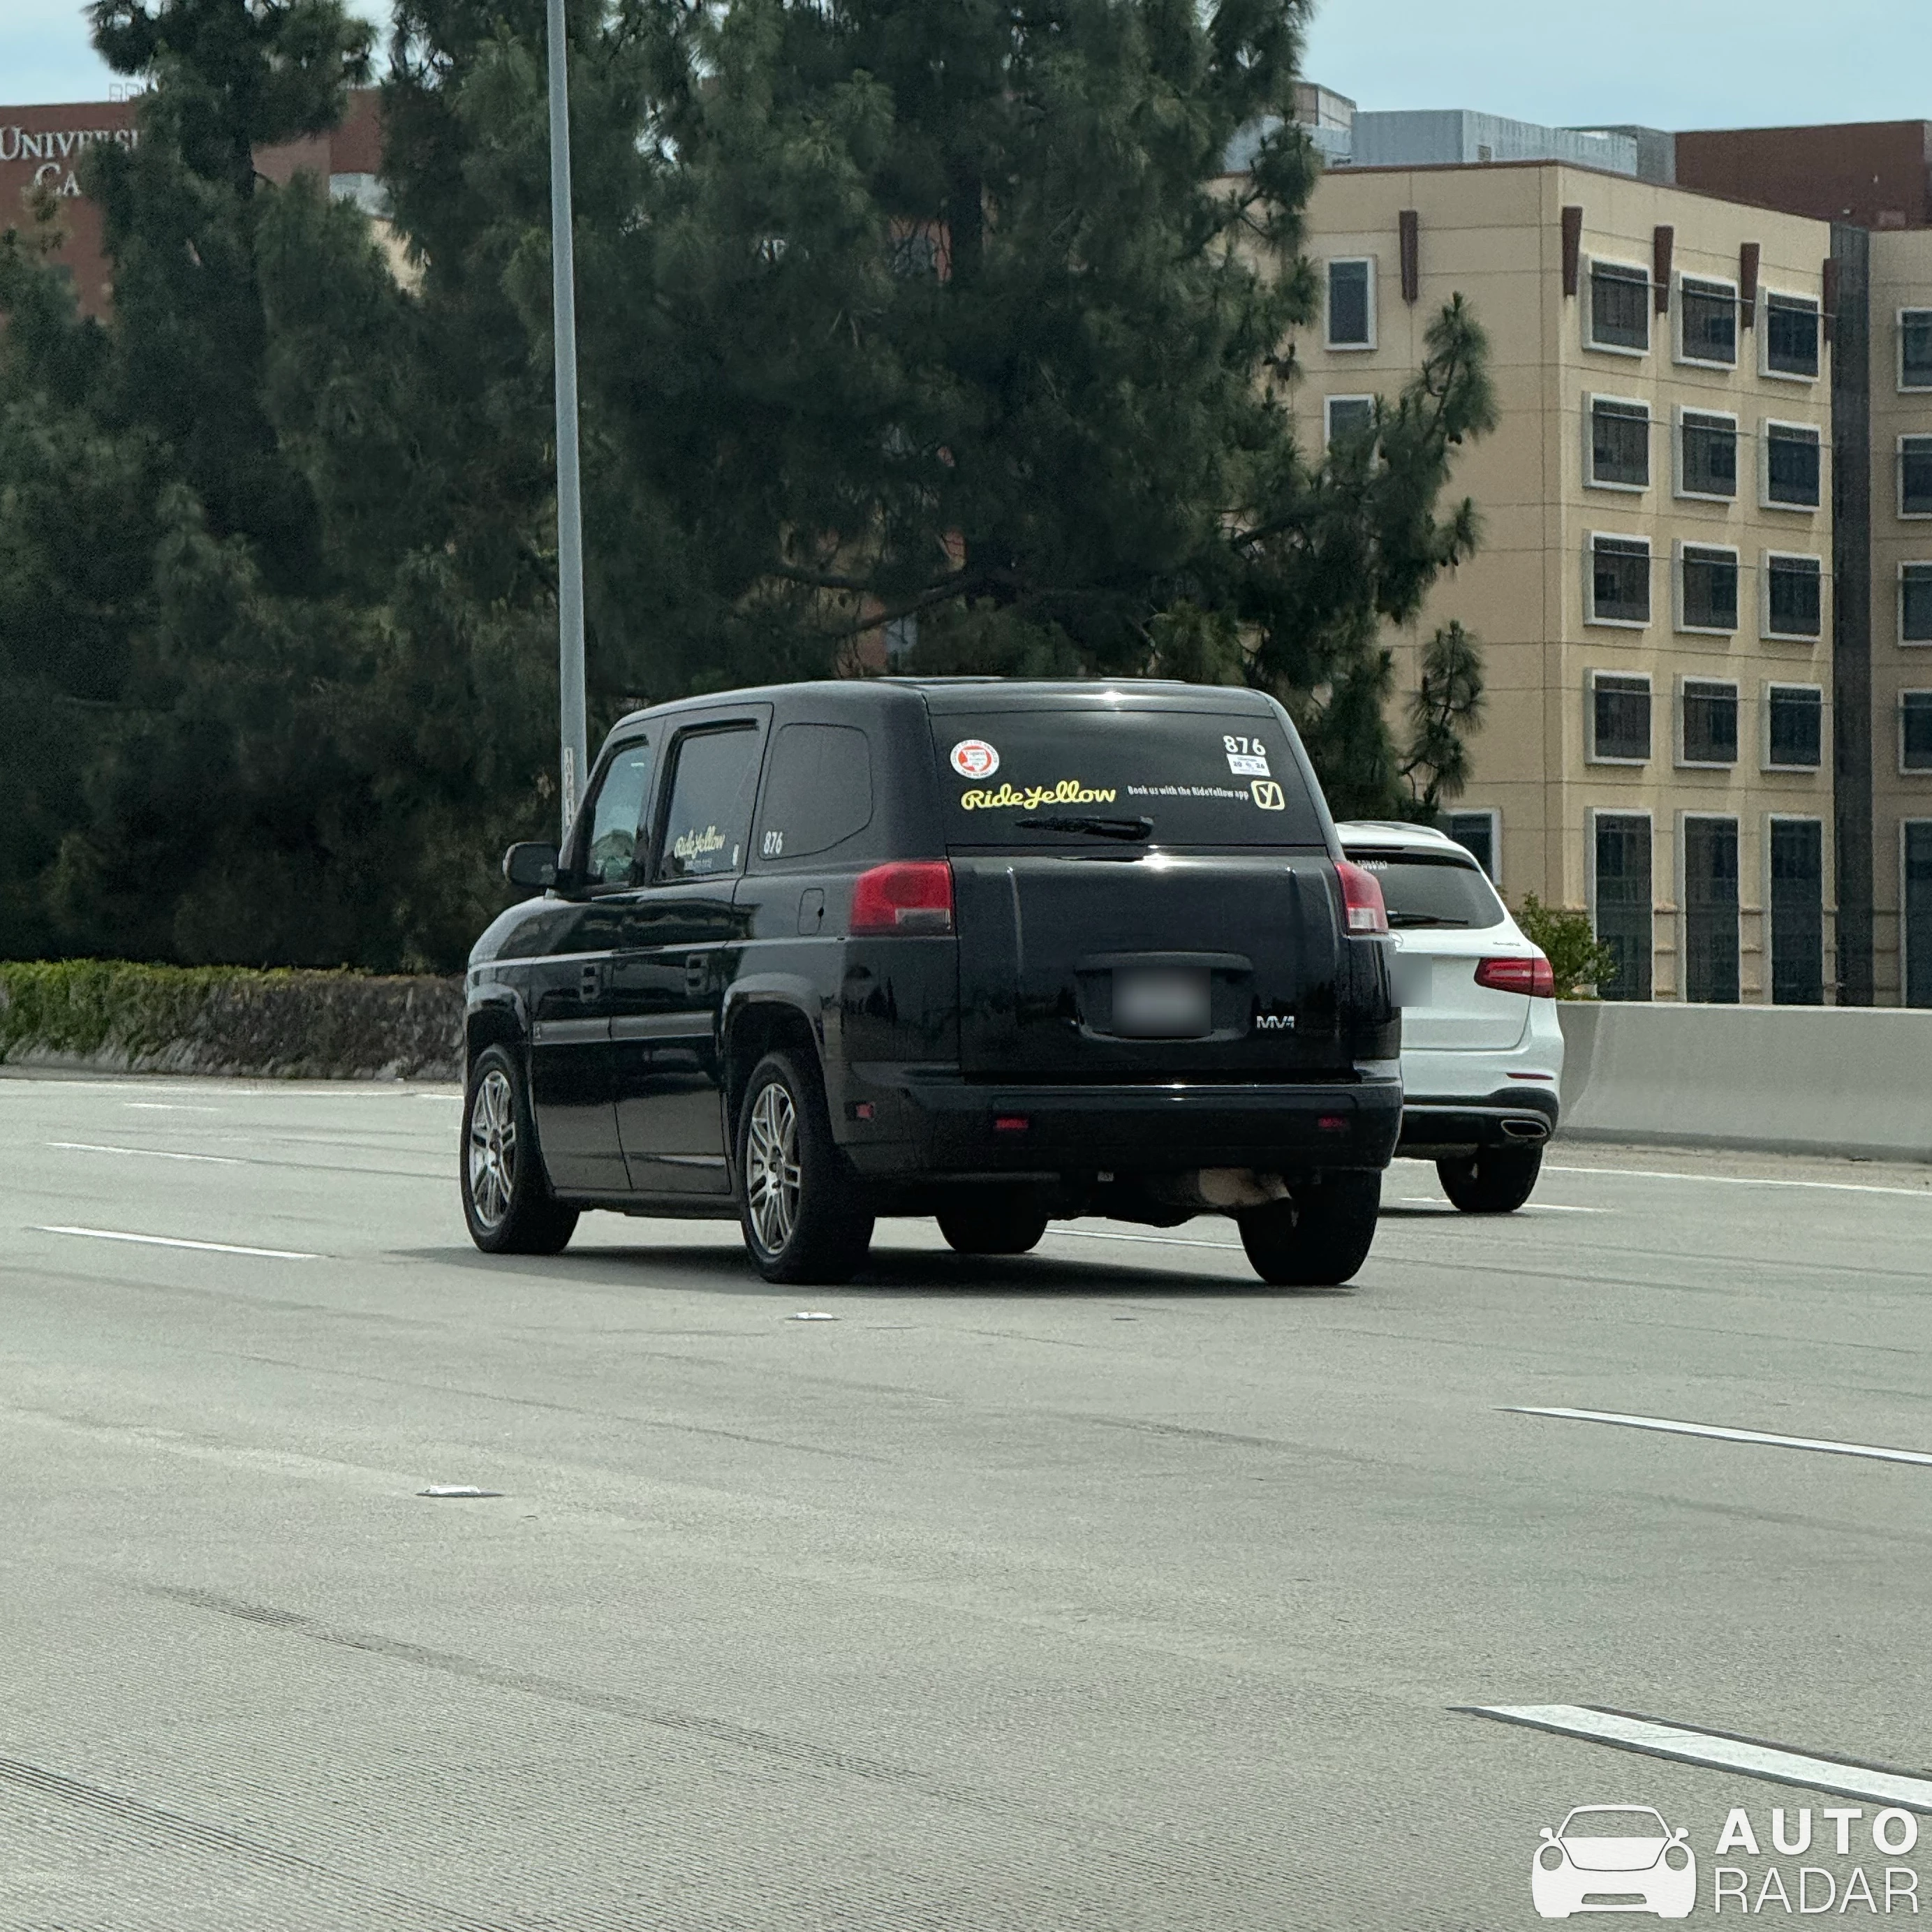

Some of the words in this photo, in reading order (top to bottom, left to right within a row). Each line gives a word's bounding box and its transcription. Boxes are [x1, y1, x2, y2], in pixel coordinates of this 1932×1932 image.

[1223, 735, 1266, 755] 876
[1127, 785, 1149, 795] Book
[1159, 785, 1178, 796] with
[1178, 786, 1191, 797] the
[1234, 790, 1249, 801] app
[763, 830, 783, 855] 876
